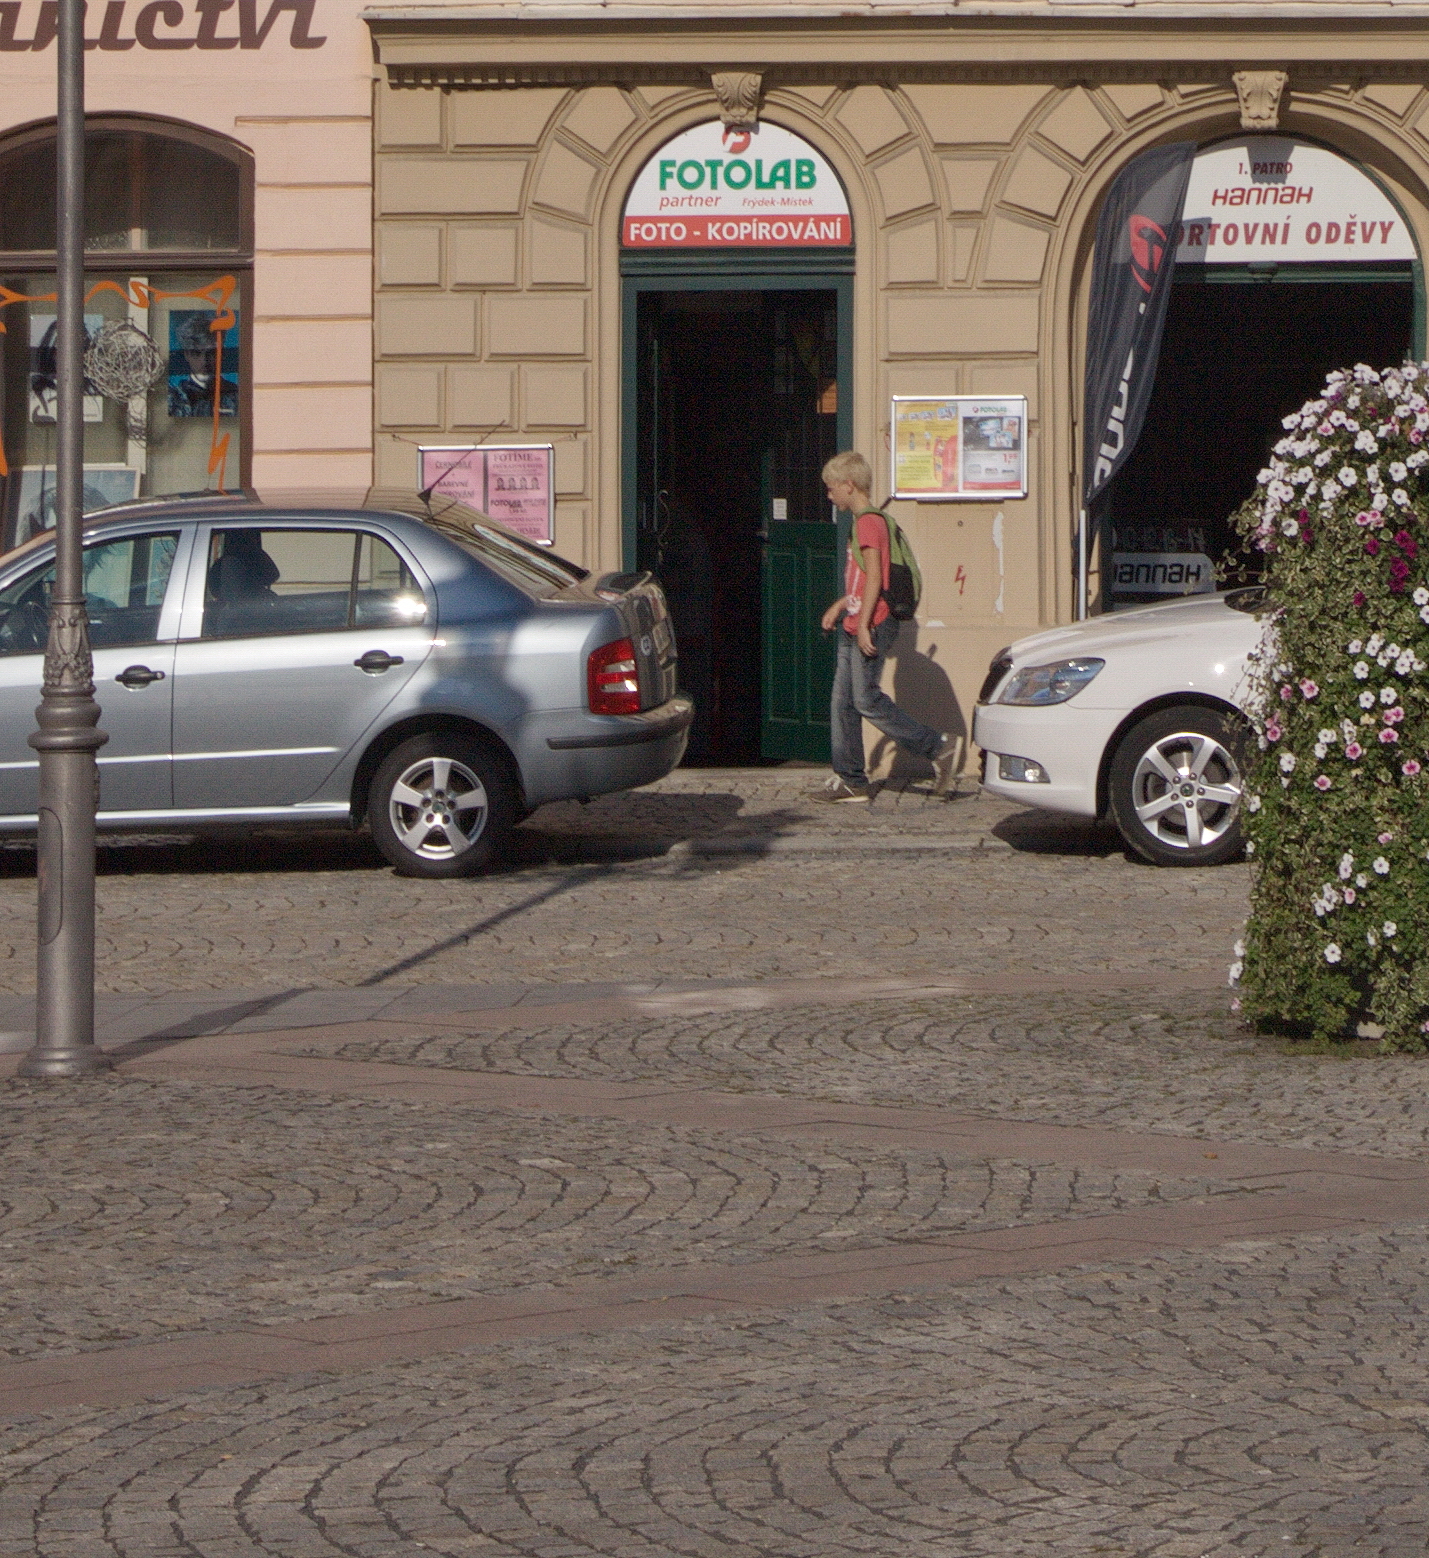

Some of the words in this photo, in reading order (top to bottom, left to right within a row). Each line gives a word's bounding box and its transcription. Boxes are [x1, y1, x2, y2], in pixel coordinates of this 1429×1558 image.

[659, 159, 817, 190] FOTOLAB
[1237, 162, 1249, 175] 1.
[1253, 162, 1293, 175] PATRO
[659, 194, 722, 210] partner
[630, 222, 687, 241] FOTO
[707, 218, 842, 241] KOPÍROVÁNÍ
[1305, 215, 1394, 245] ODĚVY
